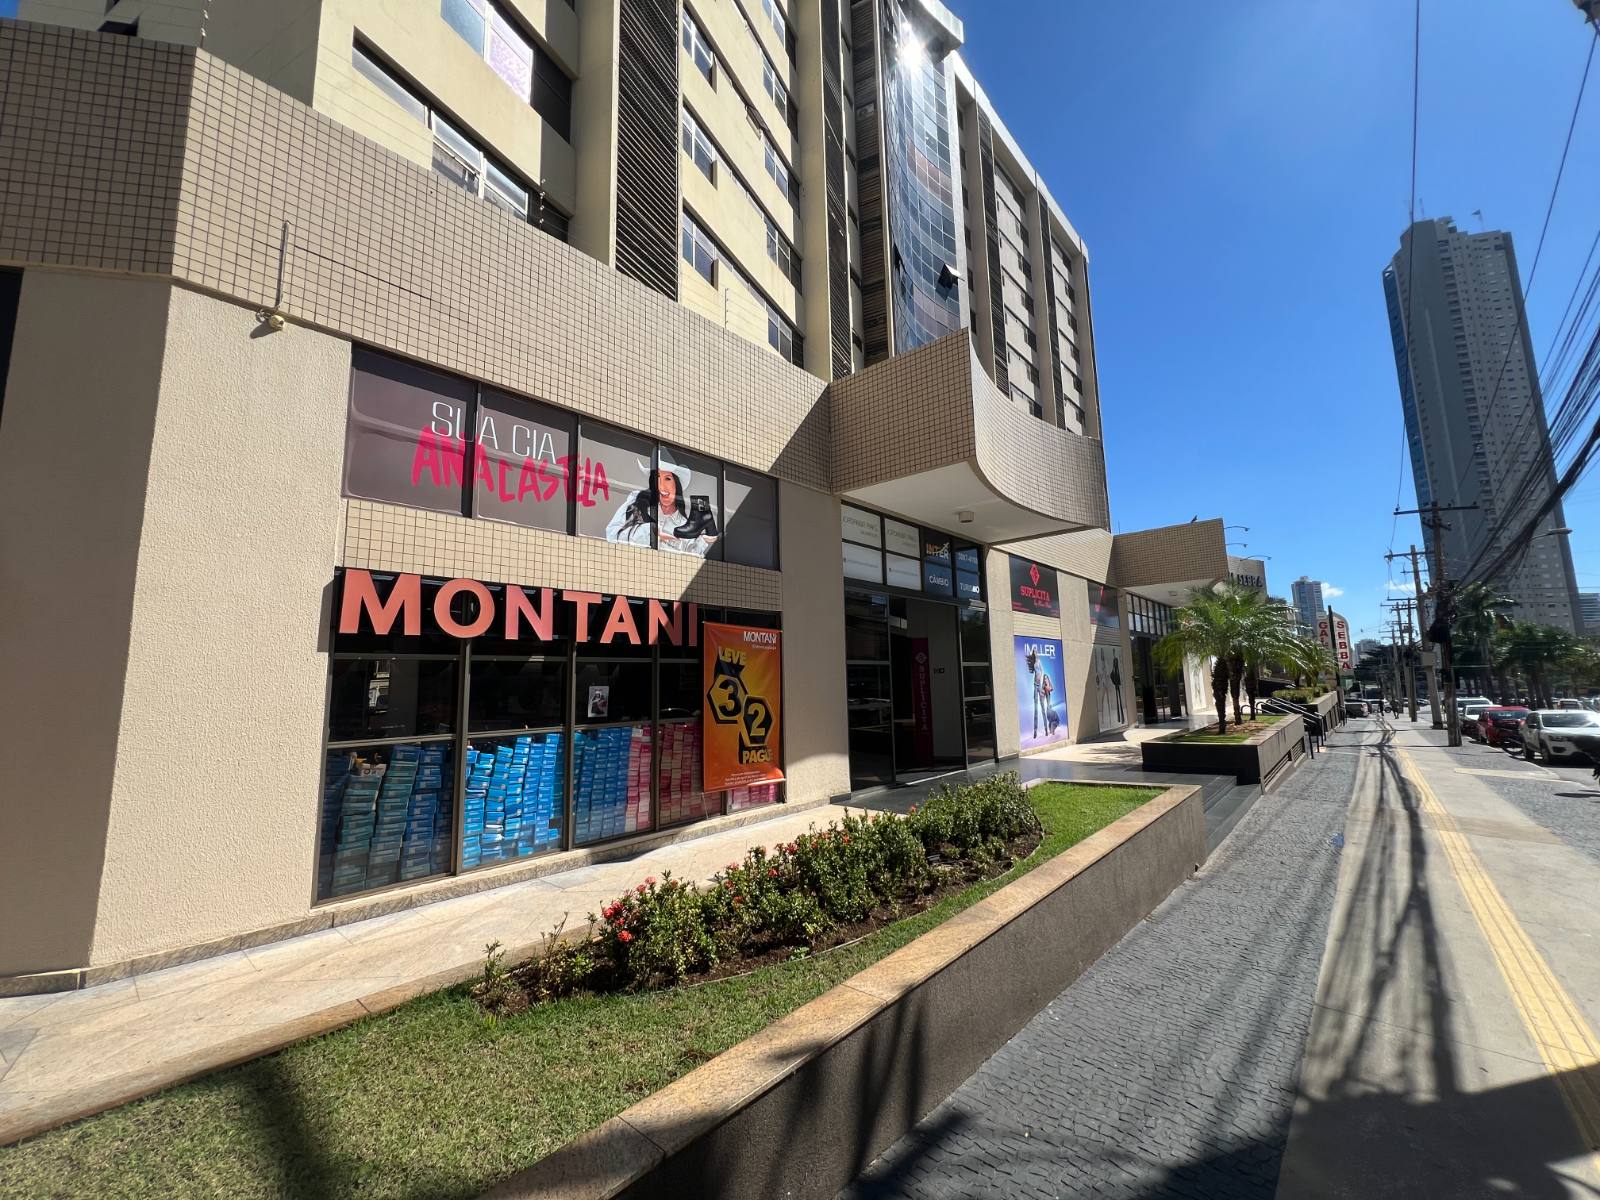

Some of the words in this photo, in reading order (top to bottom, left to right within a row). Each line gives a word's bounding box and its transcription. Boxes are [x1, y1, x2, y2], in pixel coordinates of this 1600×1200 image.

[431, 401, 499, 450] SUA
[512, 424, 556, 464] CIA
[339, 568, 698, 647] MONTANI
[718, 646, 747, 663] LEVE
[743, 631, 777, 645] MONTANI
[1336, 620, 1352, 670] SEBBA
[718, 678, 742, 718] 3
[748, 702, 766, 737] 2
